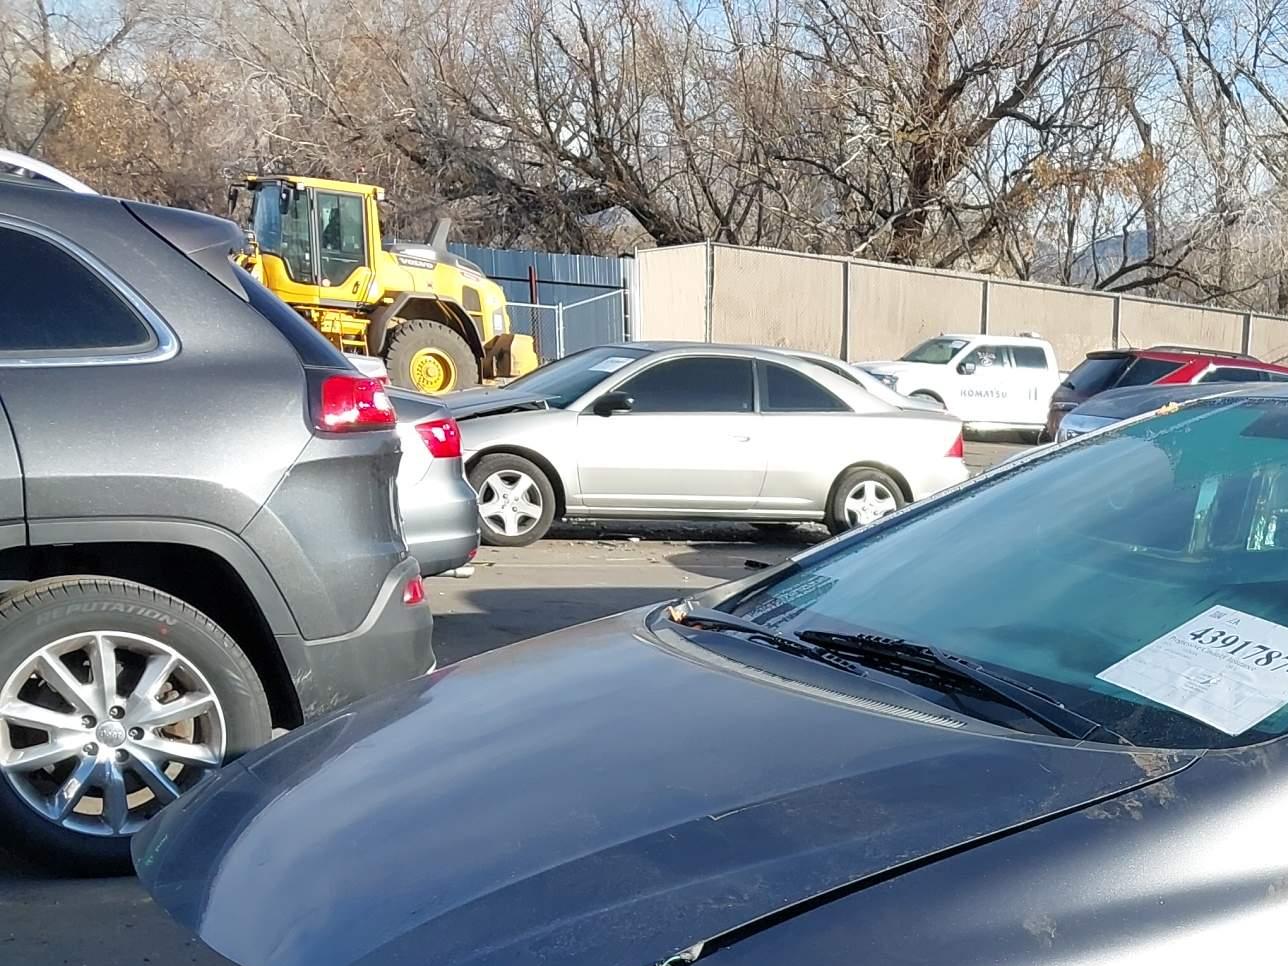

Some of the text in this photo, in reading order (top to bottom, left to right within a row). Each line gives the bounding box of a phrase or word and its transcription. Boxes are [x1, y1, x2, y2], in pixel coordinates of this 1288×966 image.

[399, 257, 434, 269] VOLVO
[960, 388, 1008, 399] KOMATSU
[35, 601, 178, 626] REPUTATION
